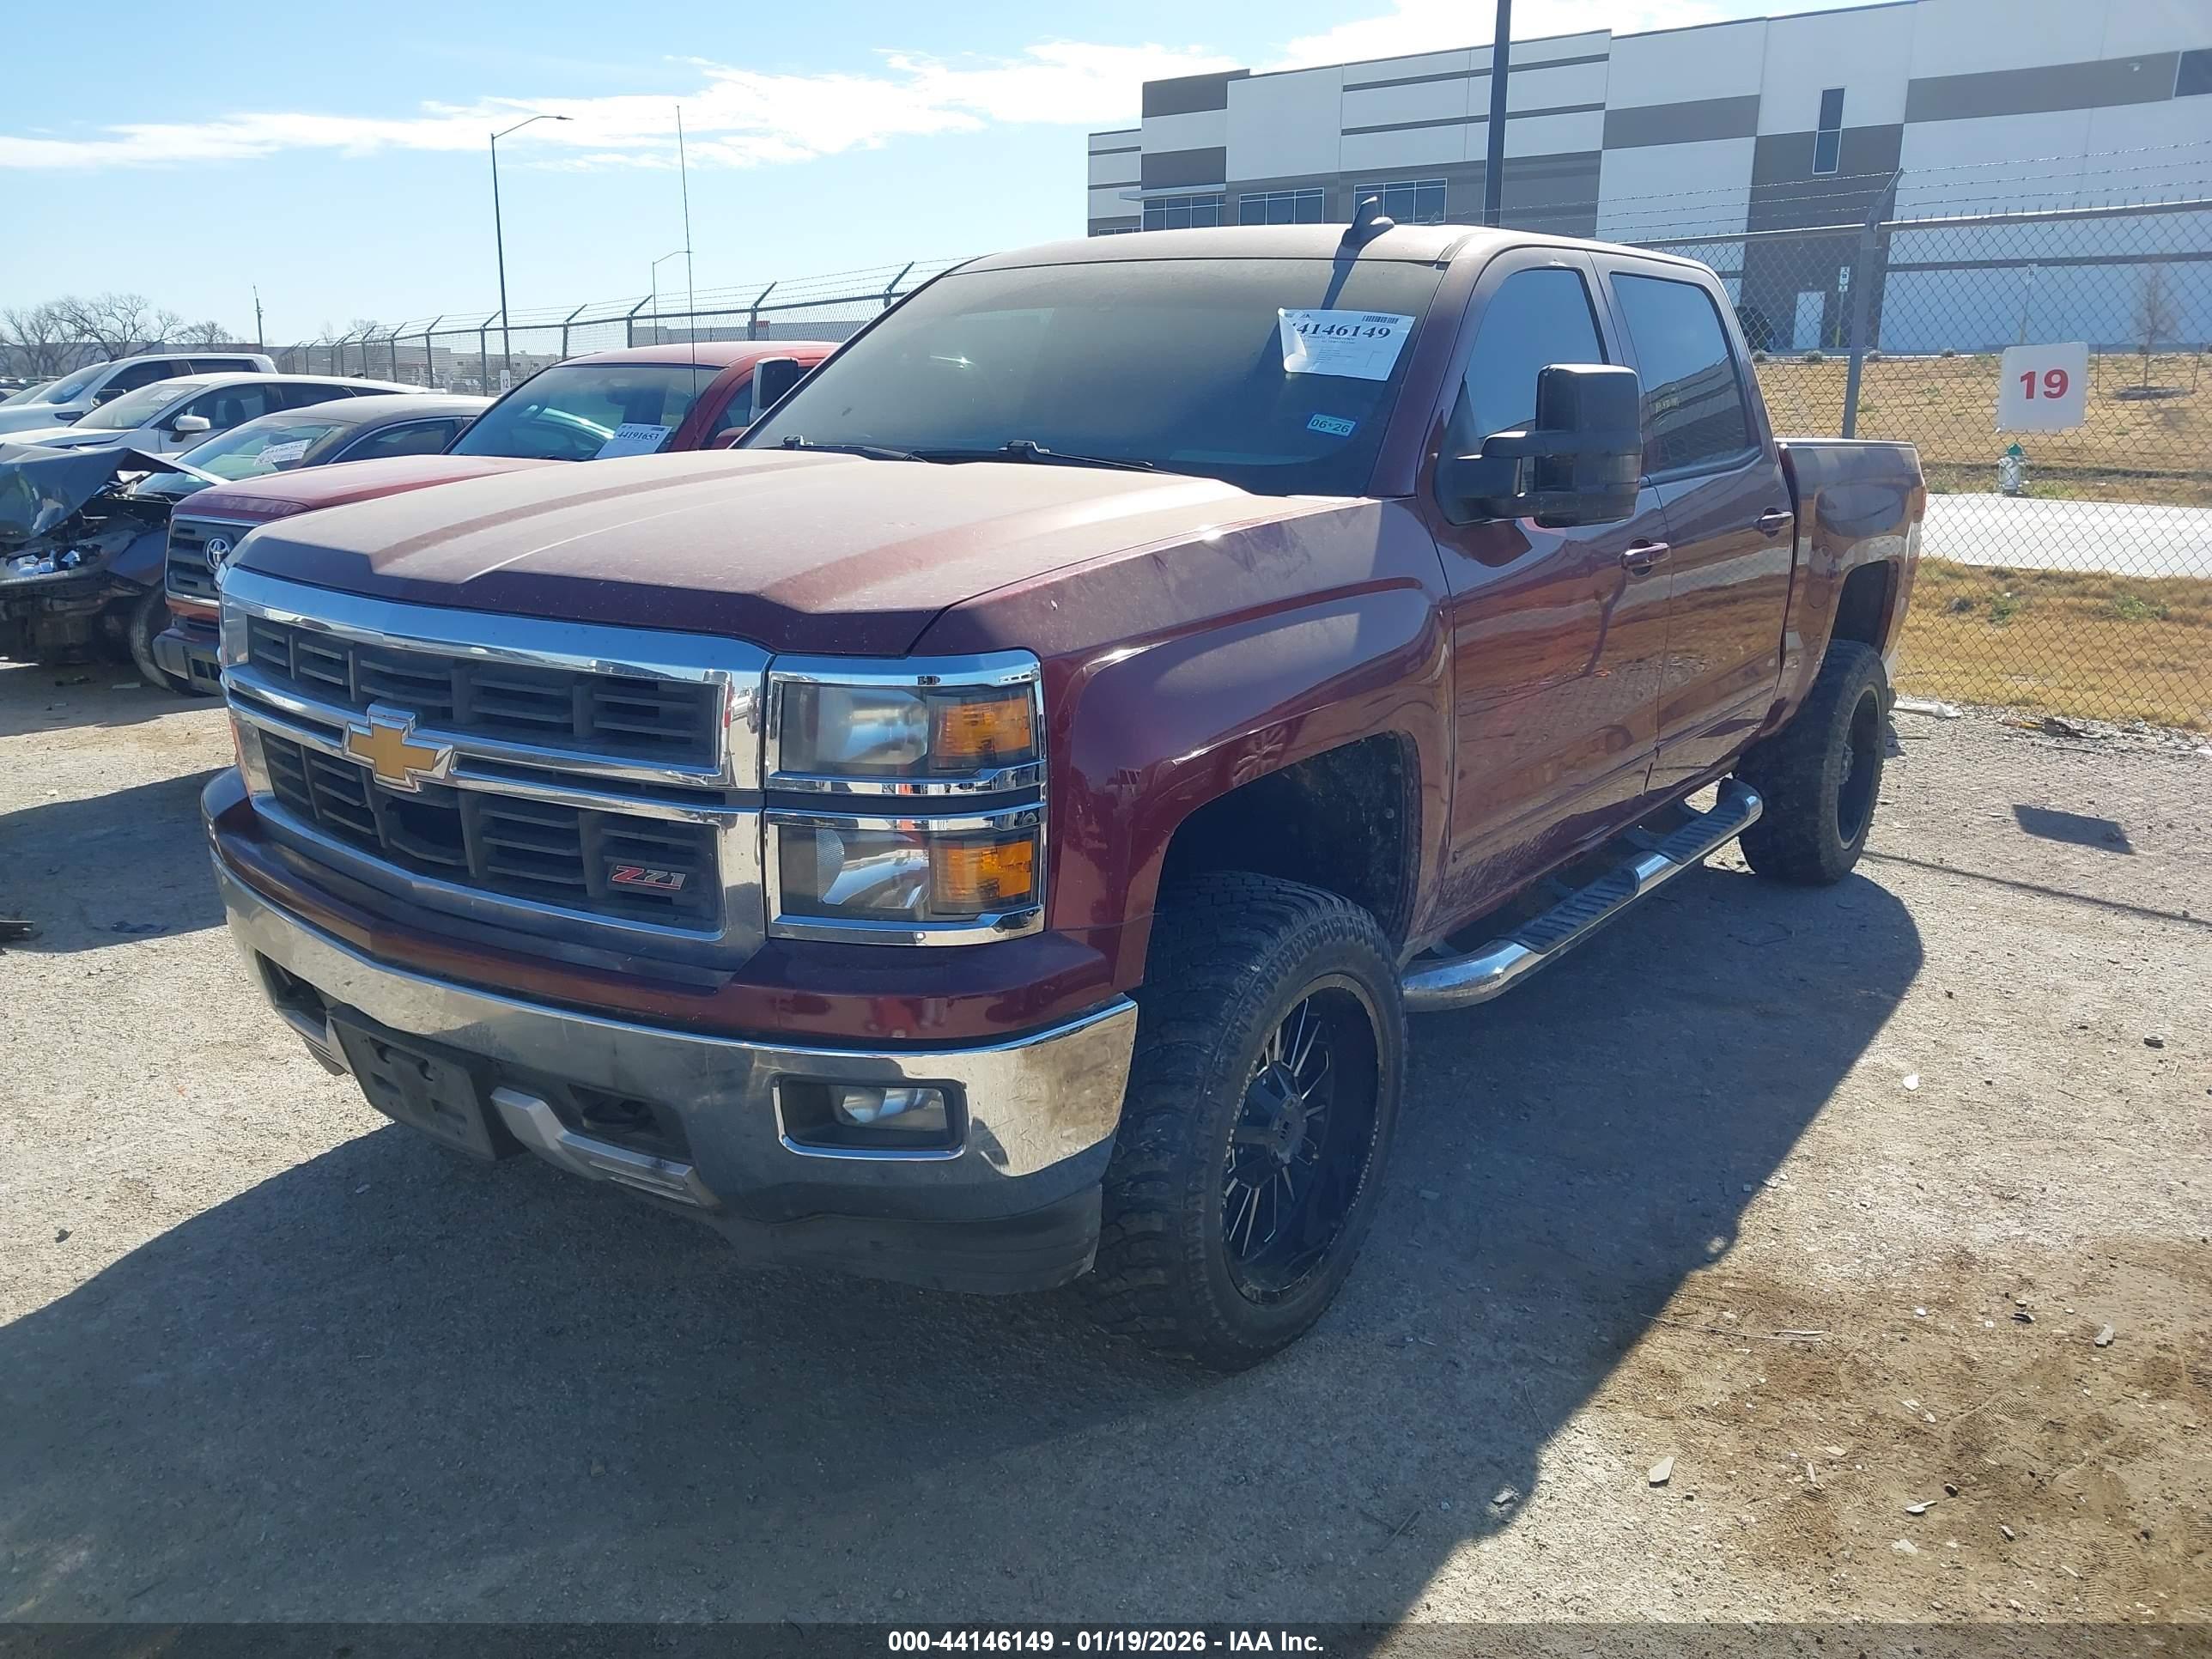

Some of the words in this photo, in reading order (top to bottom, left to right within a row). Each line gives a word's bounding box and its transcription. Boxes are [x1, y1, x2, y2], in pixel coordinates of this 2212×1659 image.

[1292, 323, 1391, 339] 4146149
[2020, 368, 2069, 399] 19
[611, 865, 686, 890] Z71
